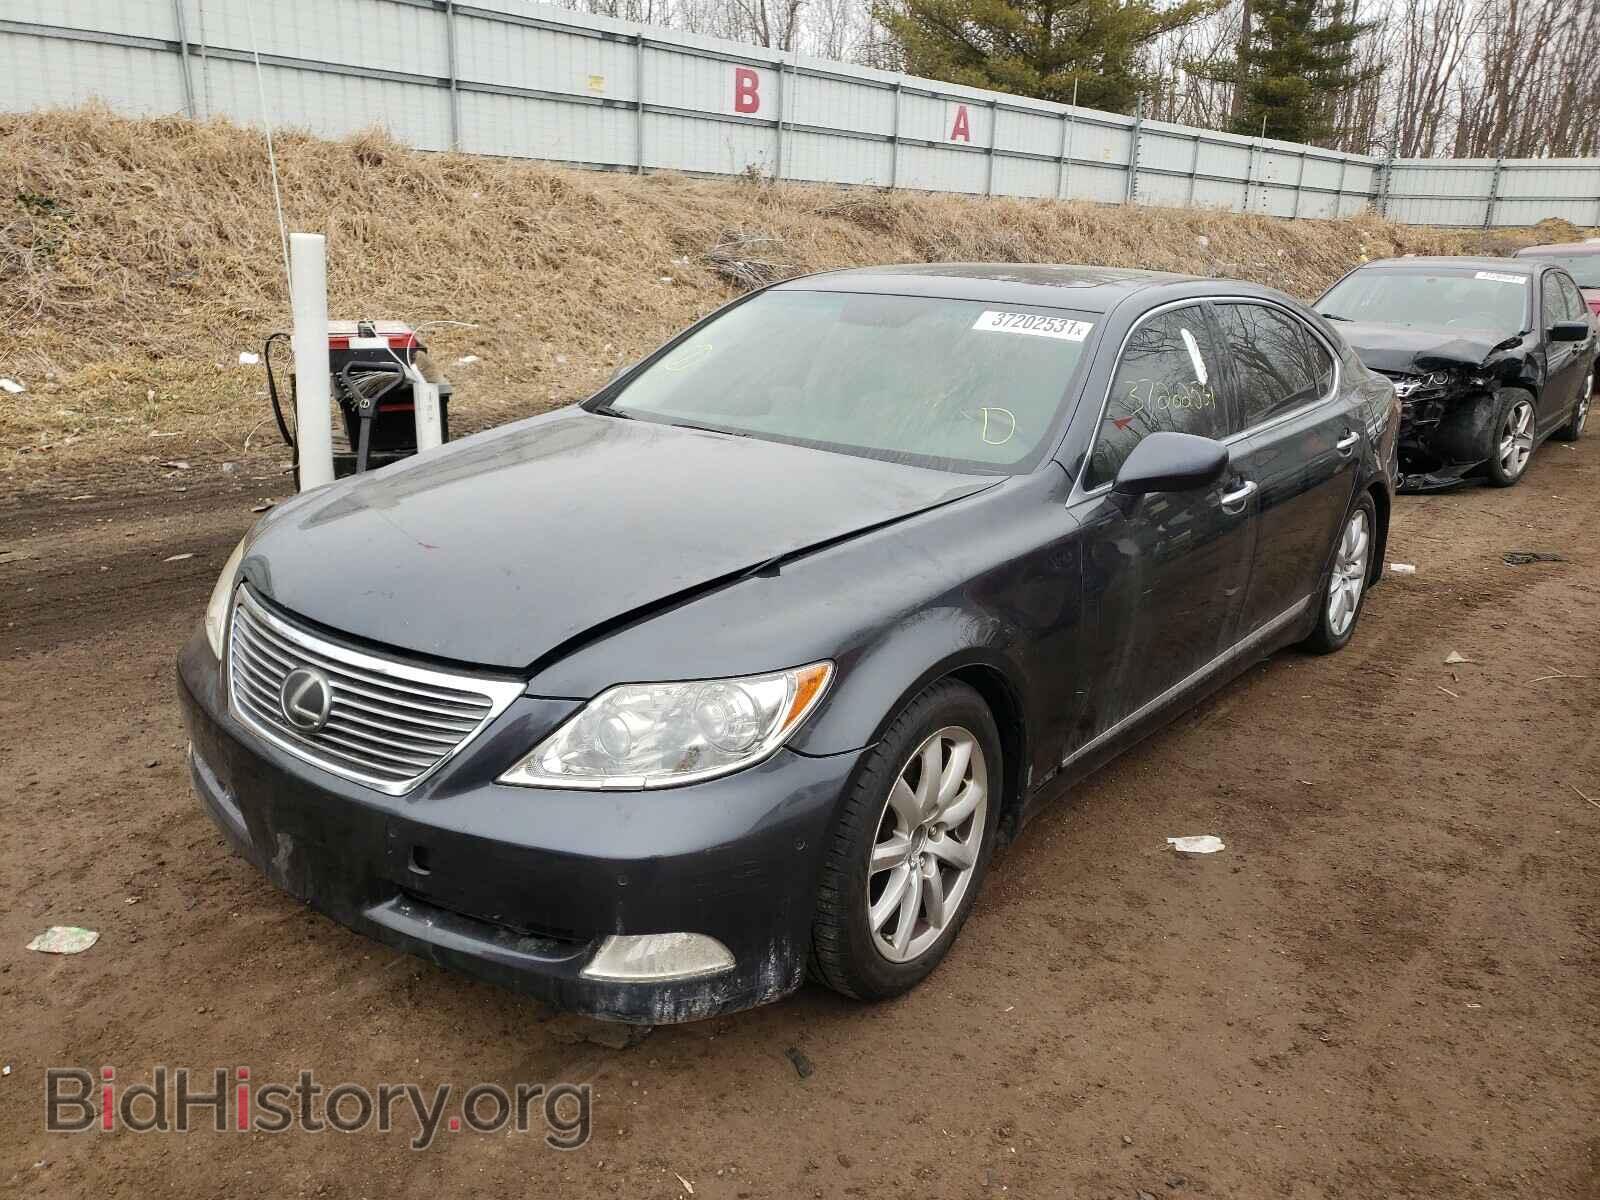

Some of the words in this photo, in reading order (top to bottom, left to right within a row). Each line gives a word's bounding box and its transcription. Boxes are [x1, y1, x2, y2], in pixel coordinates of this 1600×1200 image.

[735, 67, 761, 114] B
[950, 105, 970, 141] A
[981, 407, 1016, 445] D
